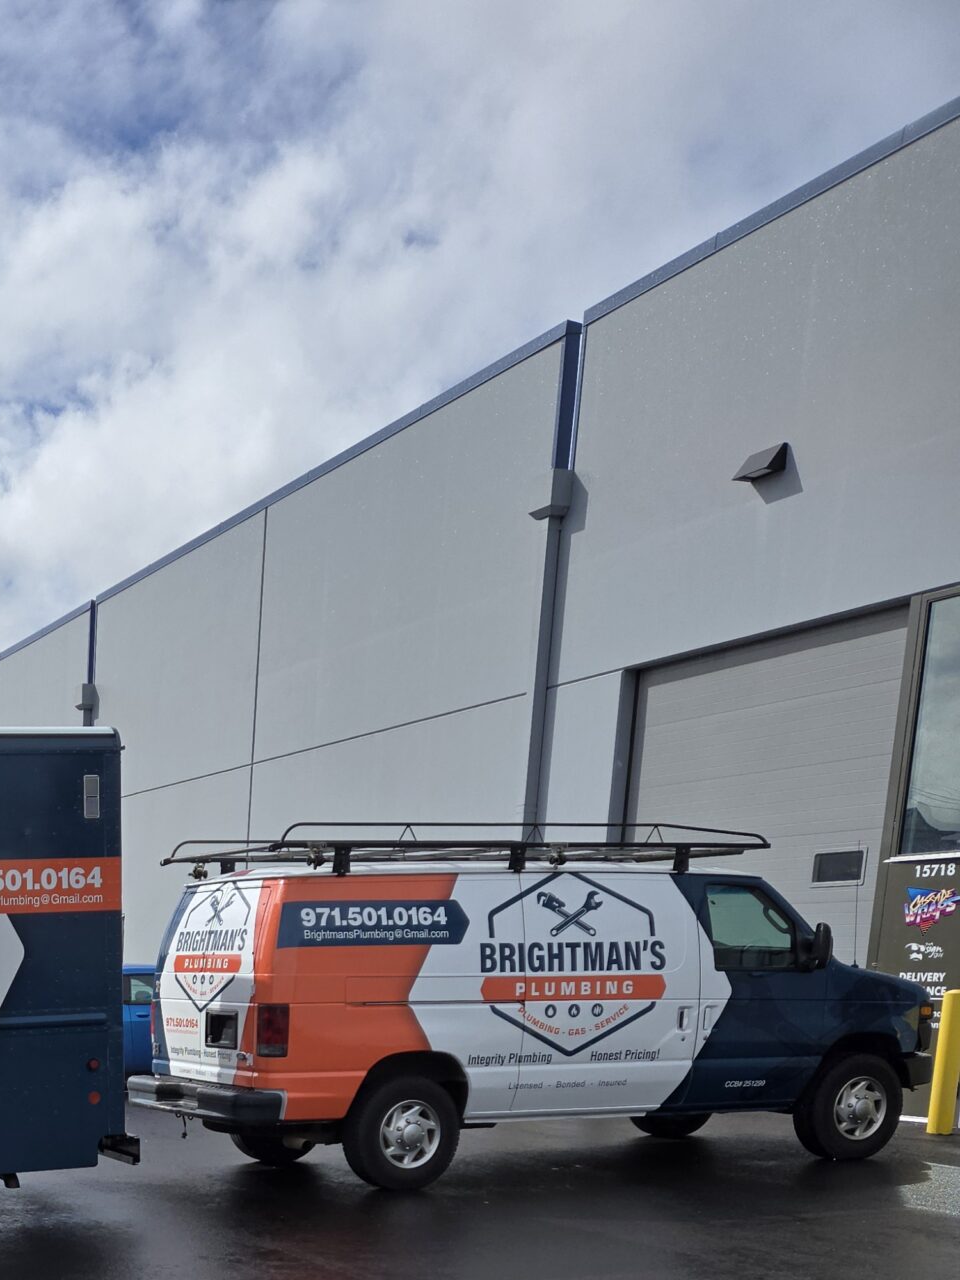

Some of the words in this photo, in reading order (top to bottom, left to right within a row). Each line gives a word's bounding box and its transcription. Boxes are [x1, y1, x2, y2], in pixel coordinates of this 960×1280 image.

[915, 863, 956, 878] 15718
[300, 906, 448, 927] 971.501.0164
[176, 928, 248, 952] BRIGHTMAN'S
[304, 929, 449, 941] BrightmansPlumbing@Gmail.com
[184, 958, 229, 969] PLUMBING
[480, 940, 666, 973] BRIGHTMAN'S
[899, 972, 946, 982] DELIVERY
[515, 980, 634, 996] PLUMBING
[517, 1006, 560, 1035] PLUMBING
[568, 1027, 586, 1036] GAS
[594, 1003, 630, 1031] SERVICE
[468, 1054, 506, 1066] Integrity
[508, 1052, 552, 1064] Plumbing
[591, 1049, 622, 1061] Honest
[625, 1048, 660, 1061] Pricing!
[508, 1082, 543, 1090] Licensed
[555, 1080, 586, 1088] Bonded
